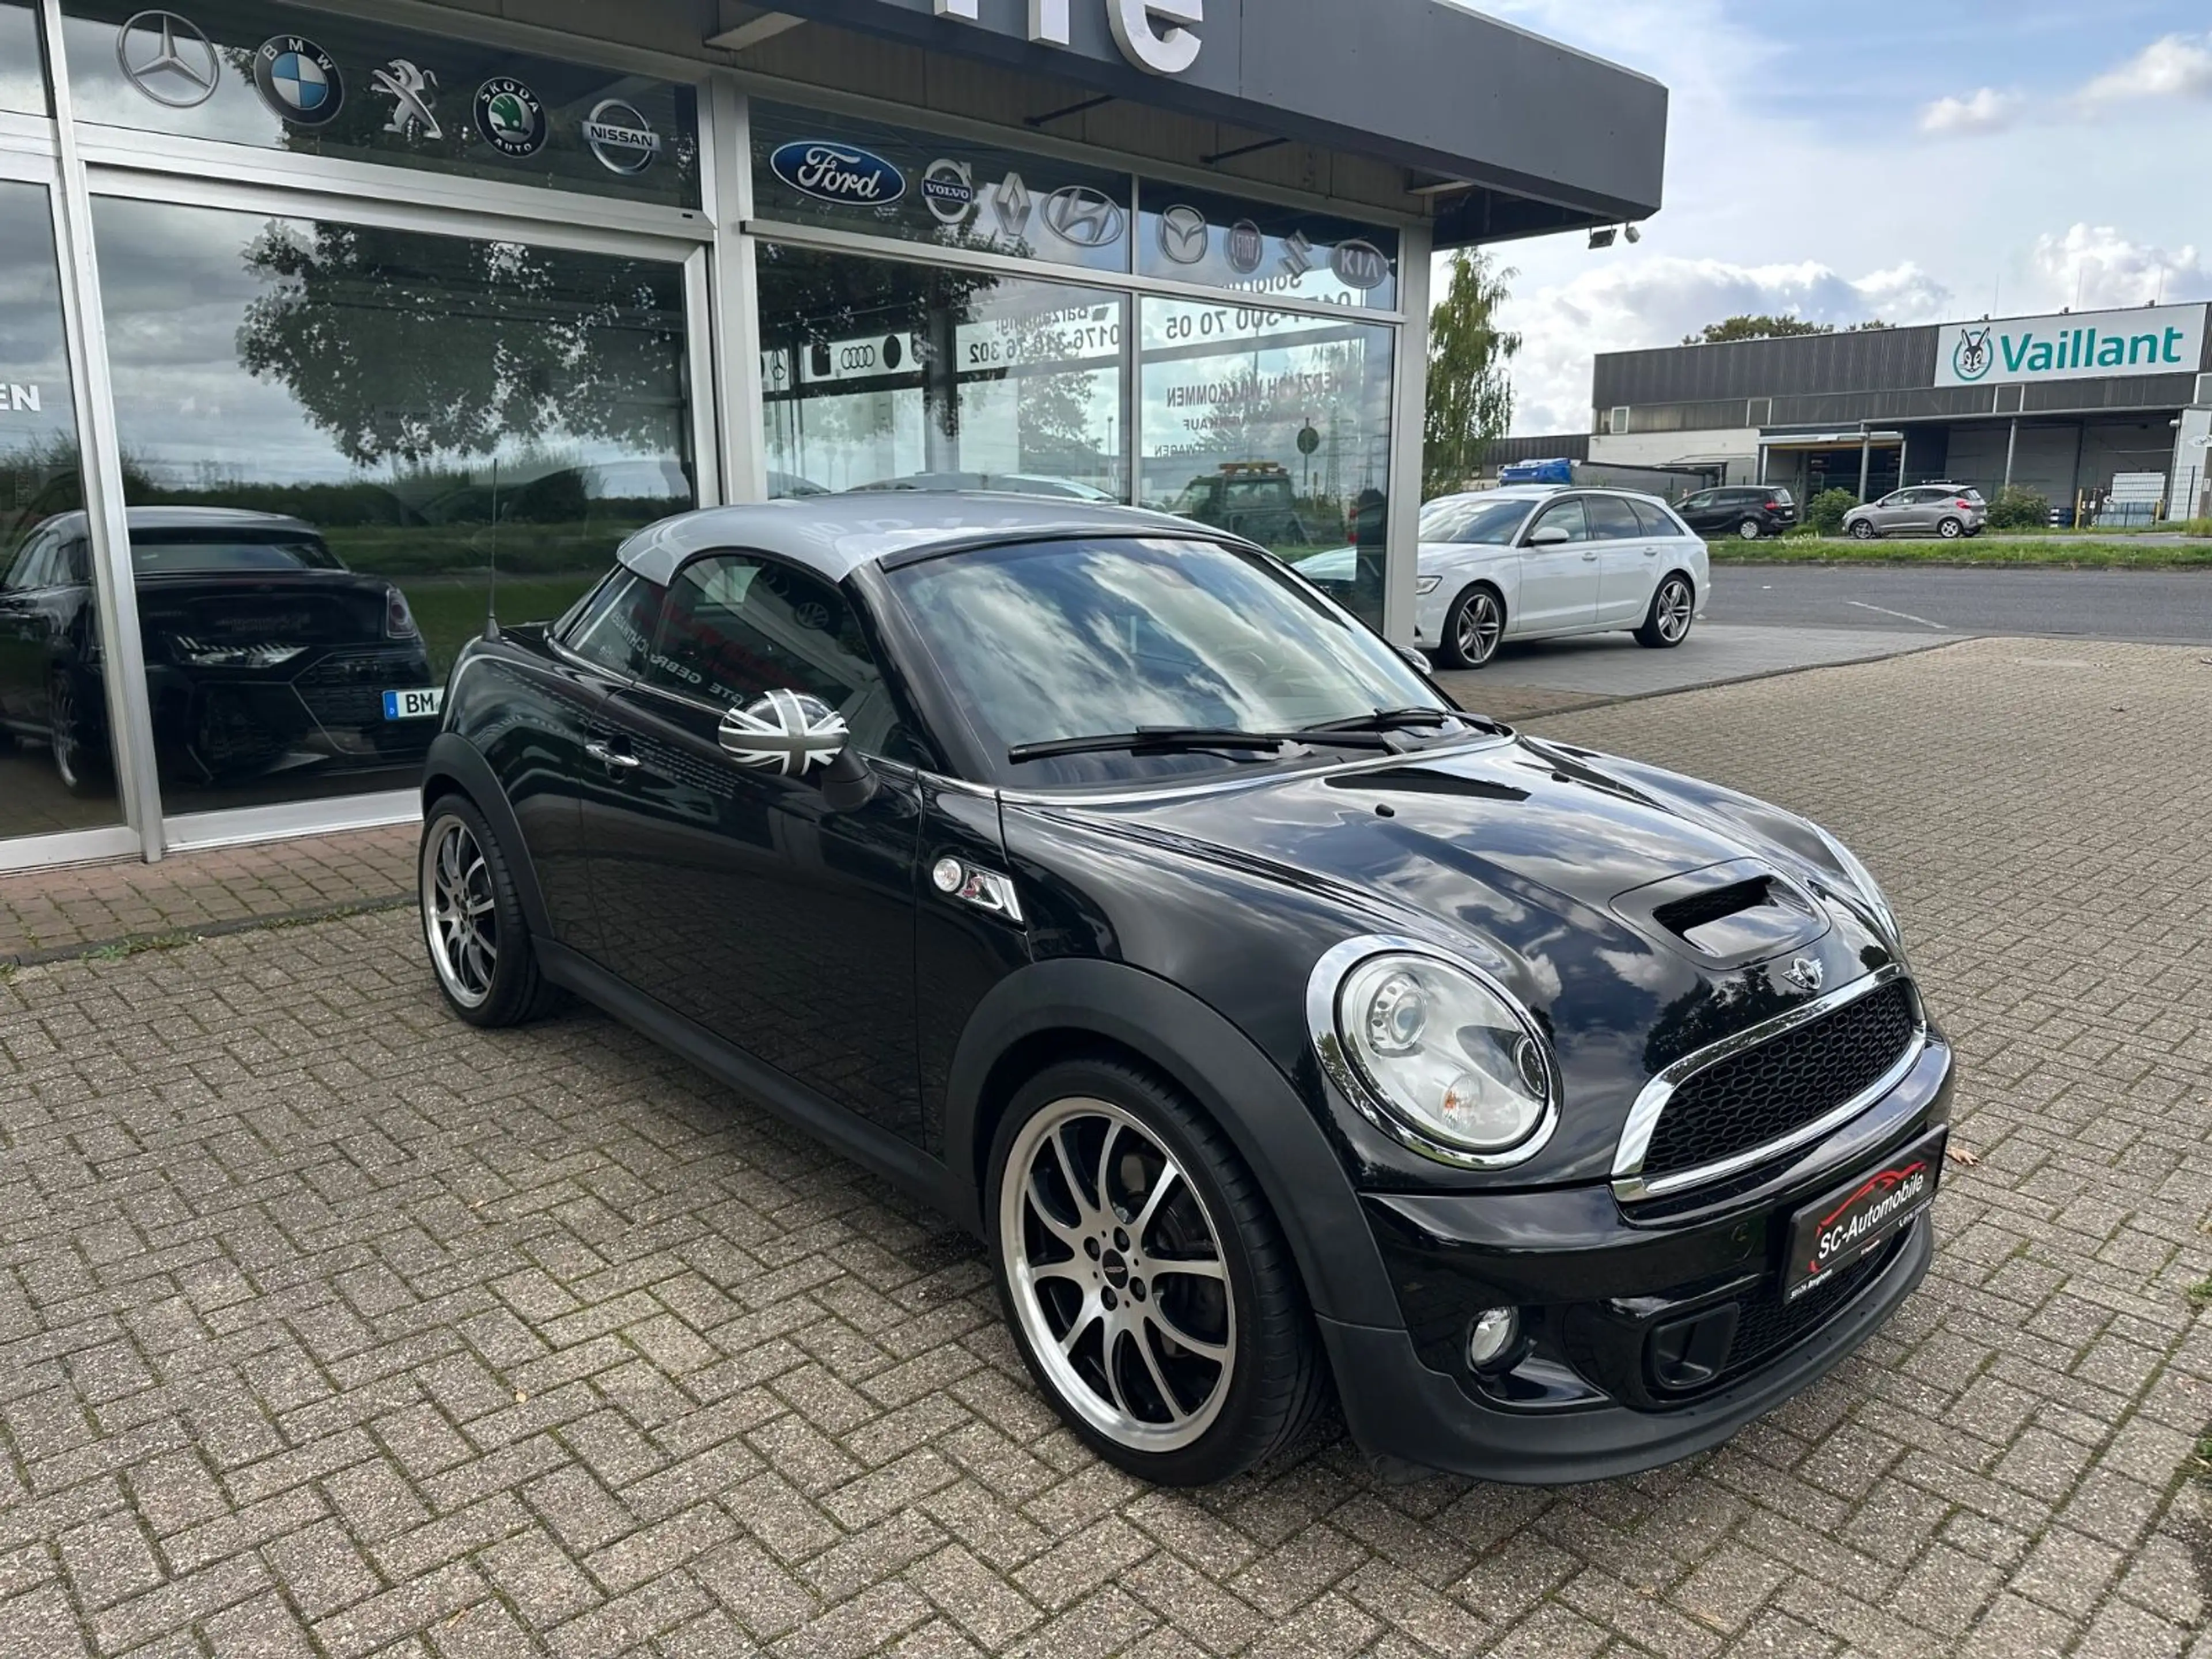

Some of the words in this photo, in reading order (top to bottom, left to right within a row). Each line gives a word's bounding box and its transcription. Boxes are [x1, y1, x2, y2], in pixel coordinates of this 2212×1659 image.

[262, 39, 332, 70] BMW
[493, 138, 533, 153] AUTO
[590, 126, 653, 147] NISSAN
[798, 146, 883, 199] Ford
[925, 182, 969, 200] VOLVO
[2001, 326, 2184, 372] Vaillant
[1818, 1172, 1924, 1259] SC-Automobile
